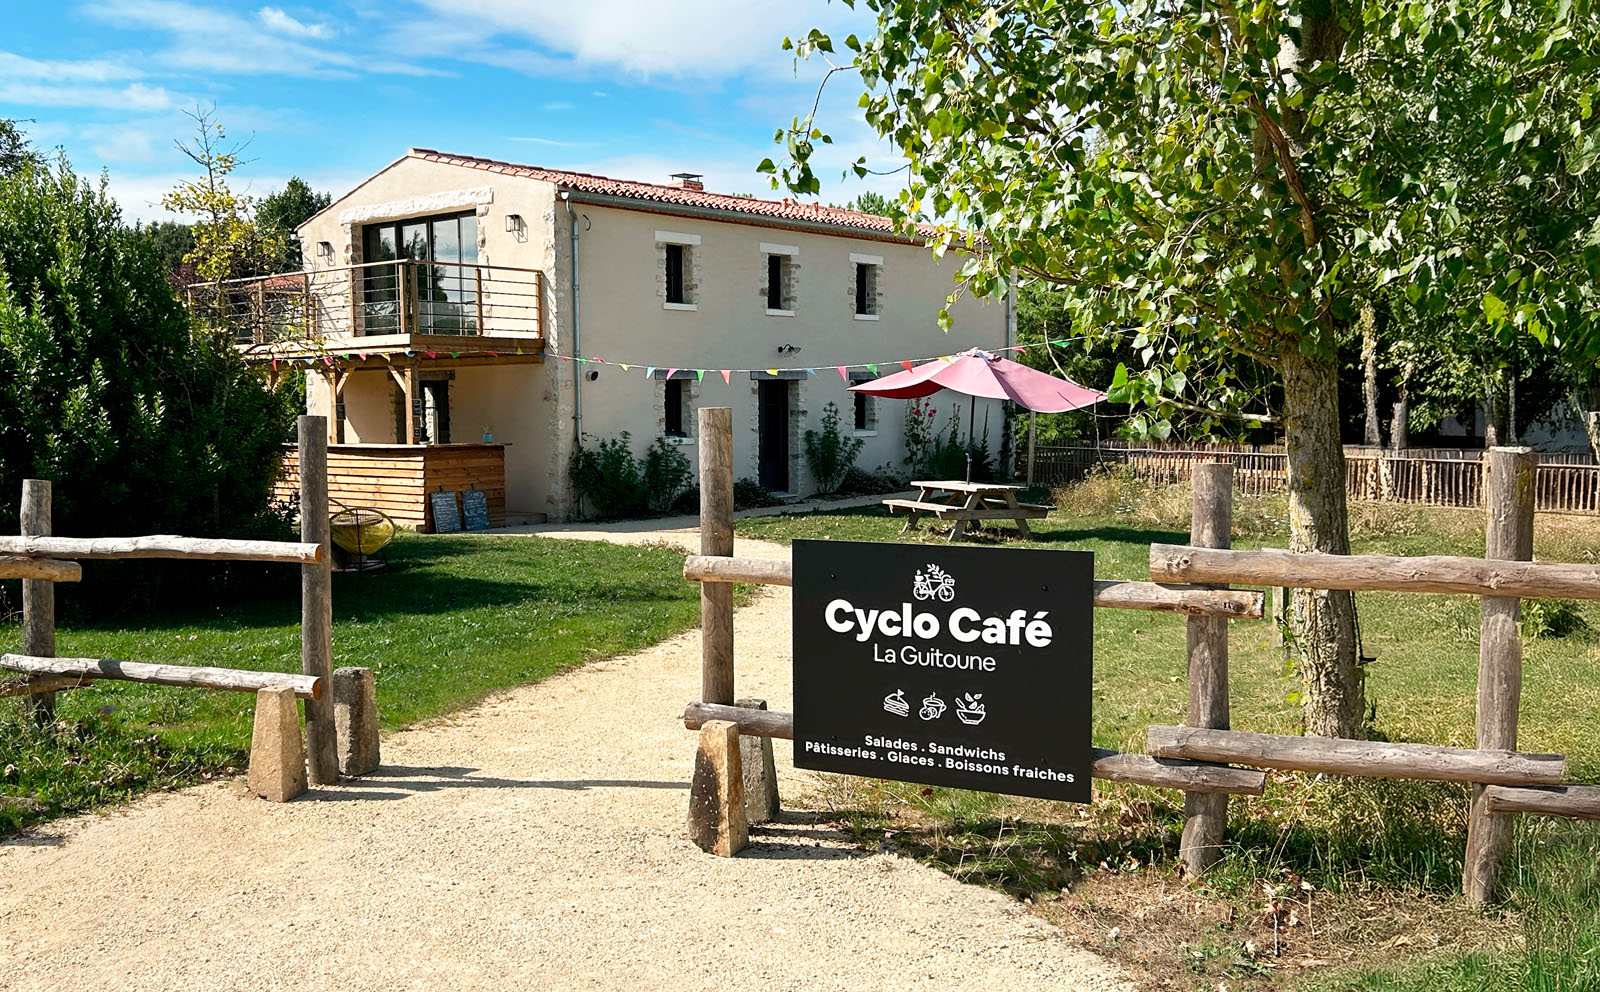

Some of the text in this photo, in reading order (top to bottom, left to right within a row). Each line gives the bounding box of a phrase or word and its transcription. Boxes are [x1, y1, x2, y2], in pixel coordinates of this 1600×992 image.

[824, 598, 1053, 648] Cyclo Café
[873, 643, 997, 672] La Guitoune
[805, 740, 877, 760] Pâtisseries
[887, 750, 935, 767] Glaces
[945, 757, 1010, 776] Boissons
[1012, 764, 1075, 783] fraiches
[864, 735, 918, 752] Salades
[928, 742, 1006, 762] Sandwichs
